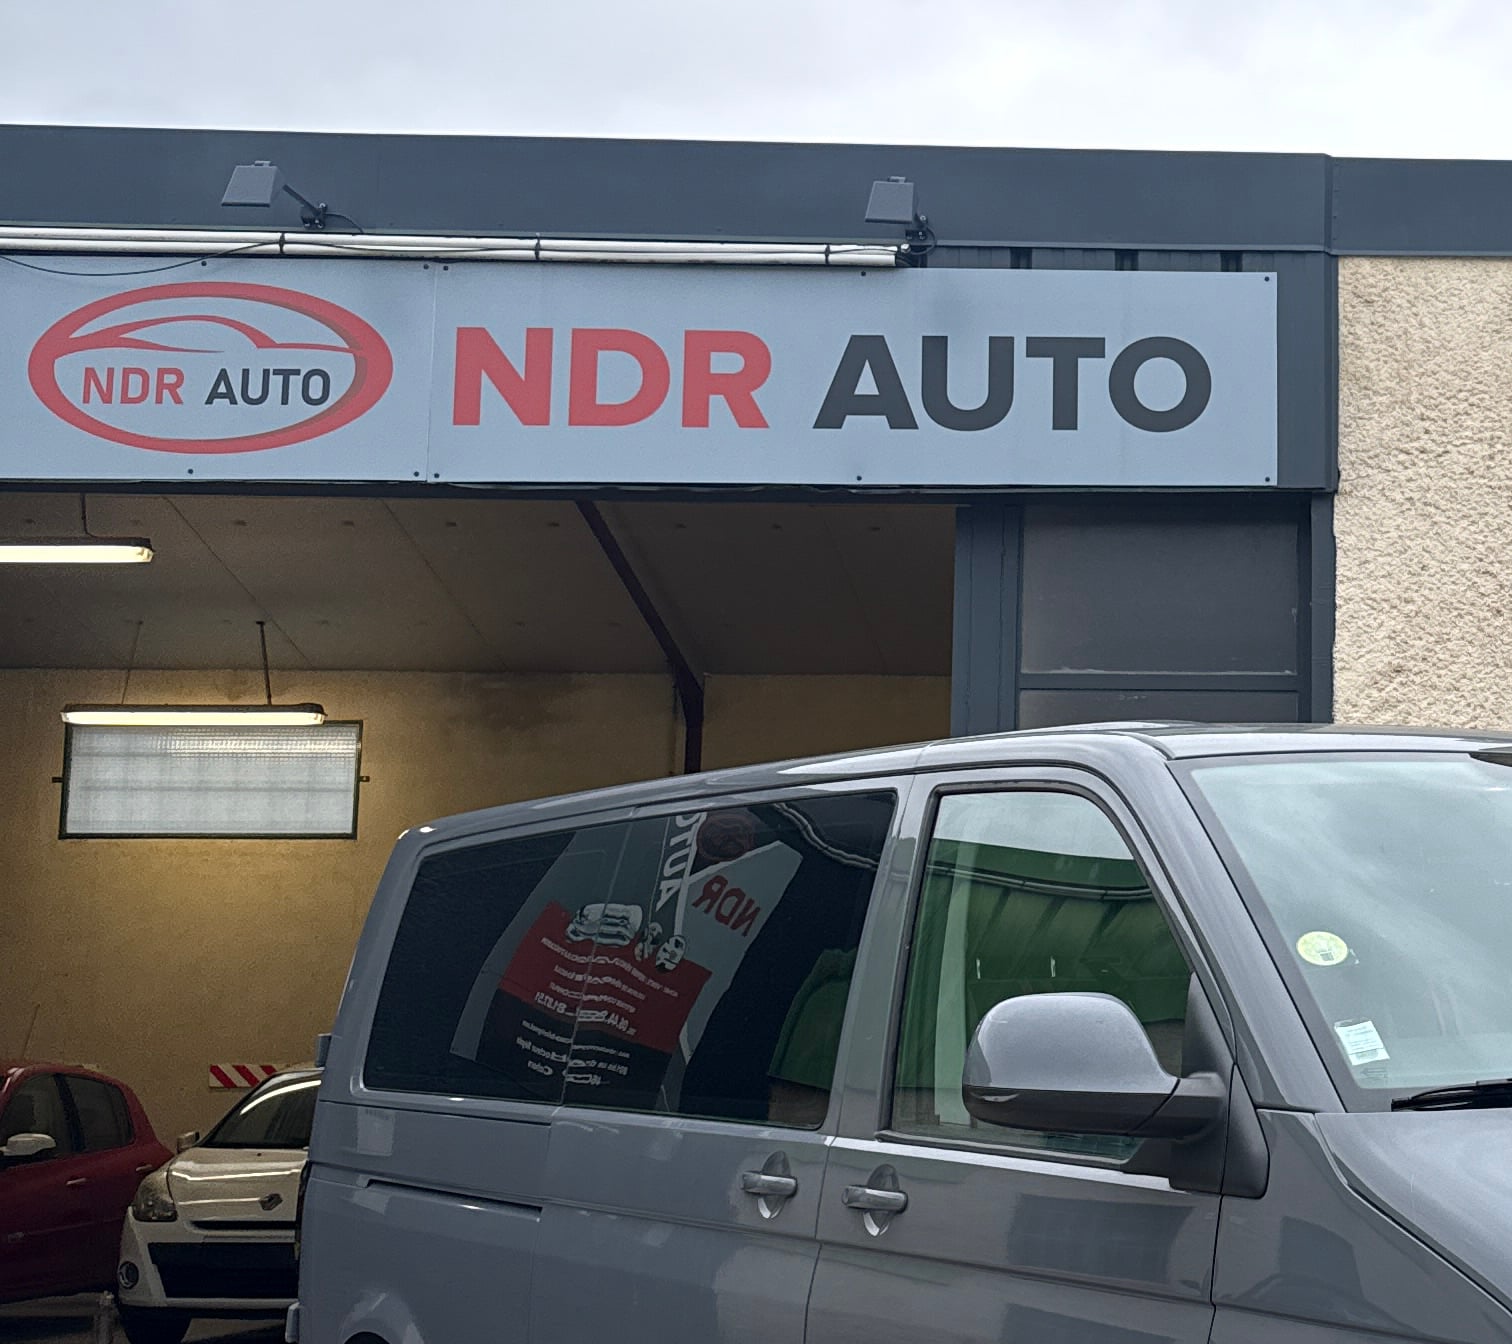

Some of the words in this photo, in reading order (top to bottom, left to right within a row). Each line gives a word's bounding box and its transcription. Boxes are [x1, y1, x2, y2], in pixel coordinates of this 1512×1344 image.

[81, 366, 185, 405] NDR
[204, 367, 331, 406] AUTO
[452, 326, 772, 430] NDR
[812, 334, 1213, 434] AUTO
